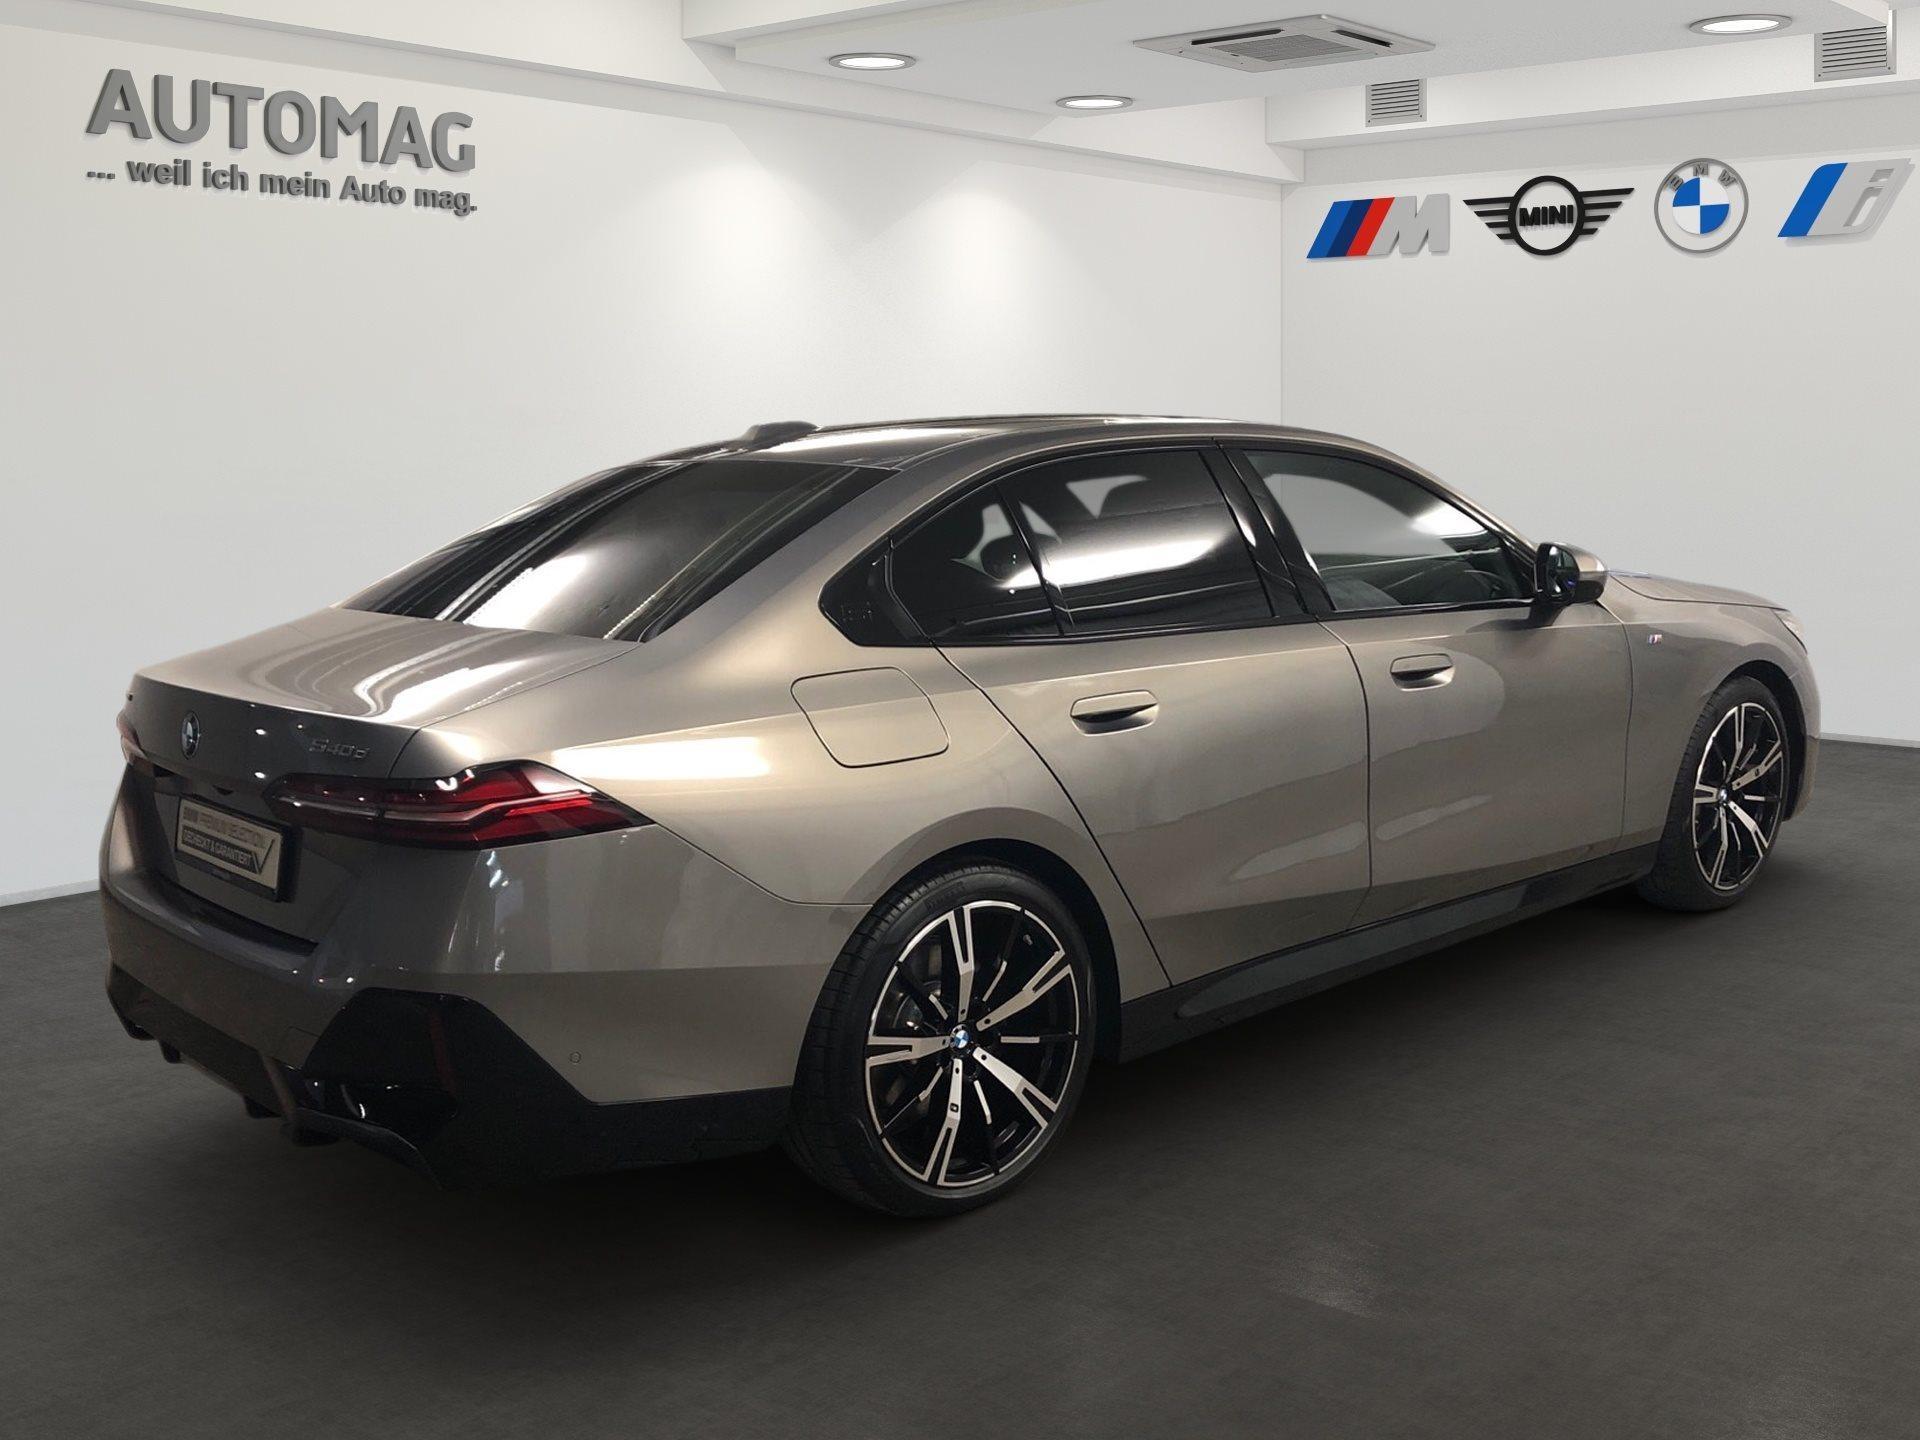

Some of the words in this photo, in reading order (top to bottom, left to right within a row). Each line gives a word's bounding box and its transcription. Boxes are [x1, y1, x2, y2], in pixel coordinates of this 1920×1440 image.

[86, 68, 476, 173] AUTOMAG
[126, 158, 191, 187] weil
[203, 161, 248, 191] ich
[260, 171, 330, 199] mein
[340, 175, 406, 205] Auto
[414, 187, 477, 217] mag.
[1519, 203, 1574, 227] MINI
